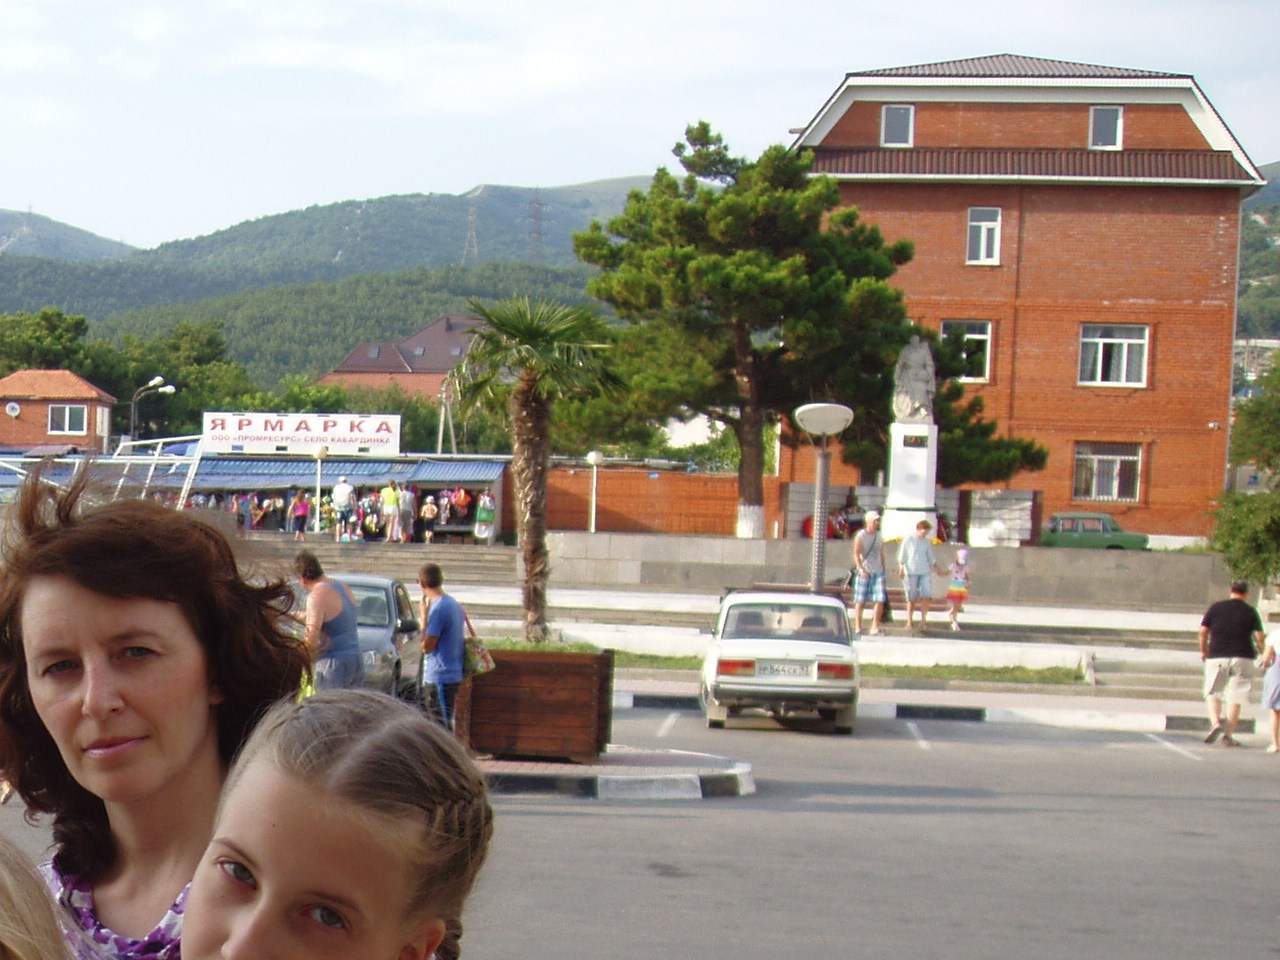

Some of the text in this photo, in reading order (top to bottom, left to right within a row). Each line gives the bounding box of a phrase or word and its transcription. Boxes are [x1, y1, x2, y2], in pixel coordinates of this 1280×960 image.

[210, 418, 393, 434] ЯРМАРКА
[304, 435, 327, 443] СЕЛО
[330, 436, 391, 444] КАБАРДИНКА
